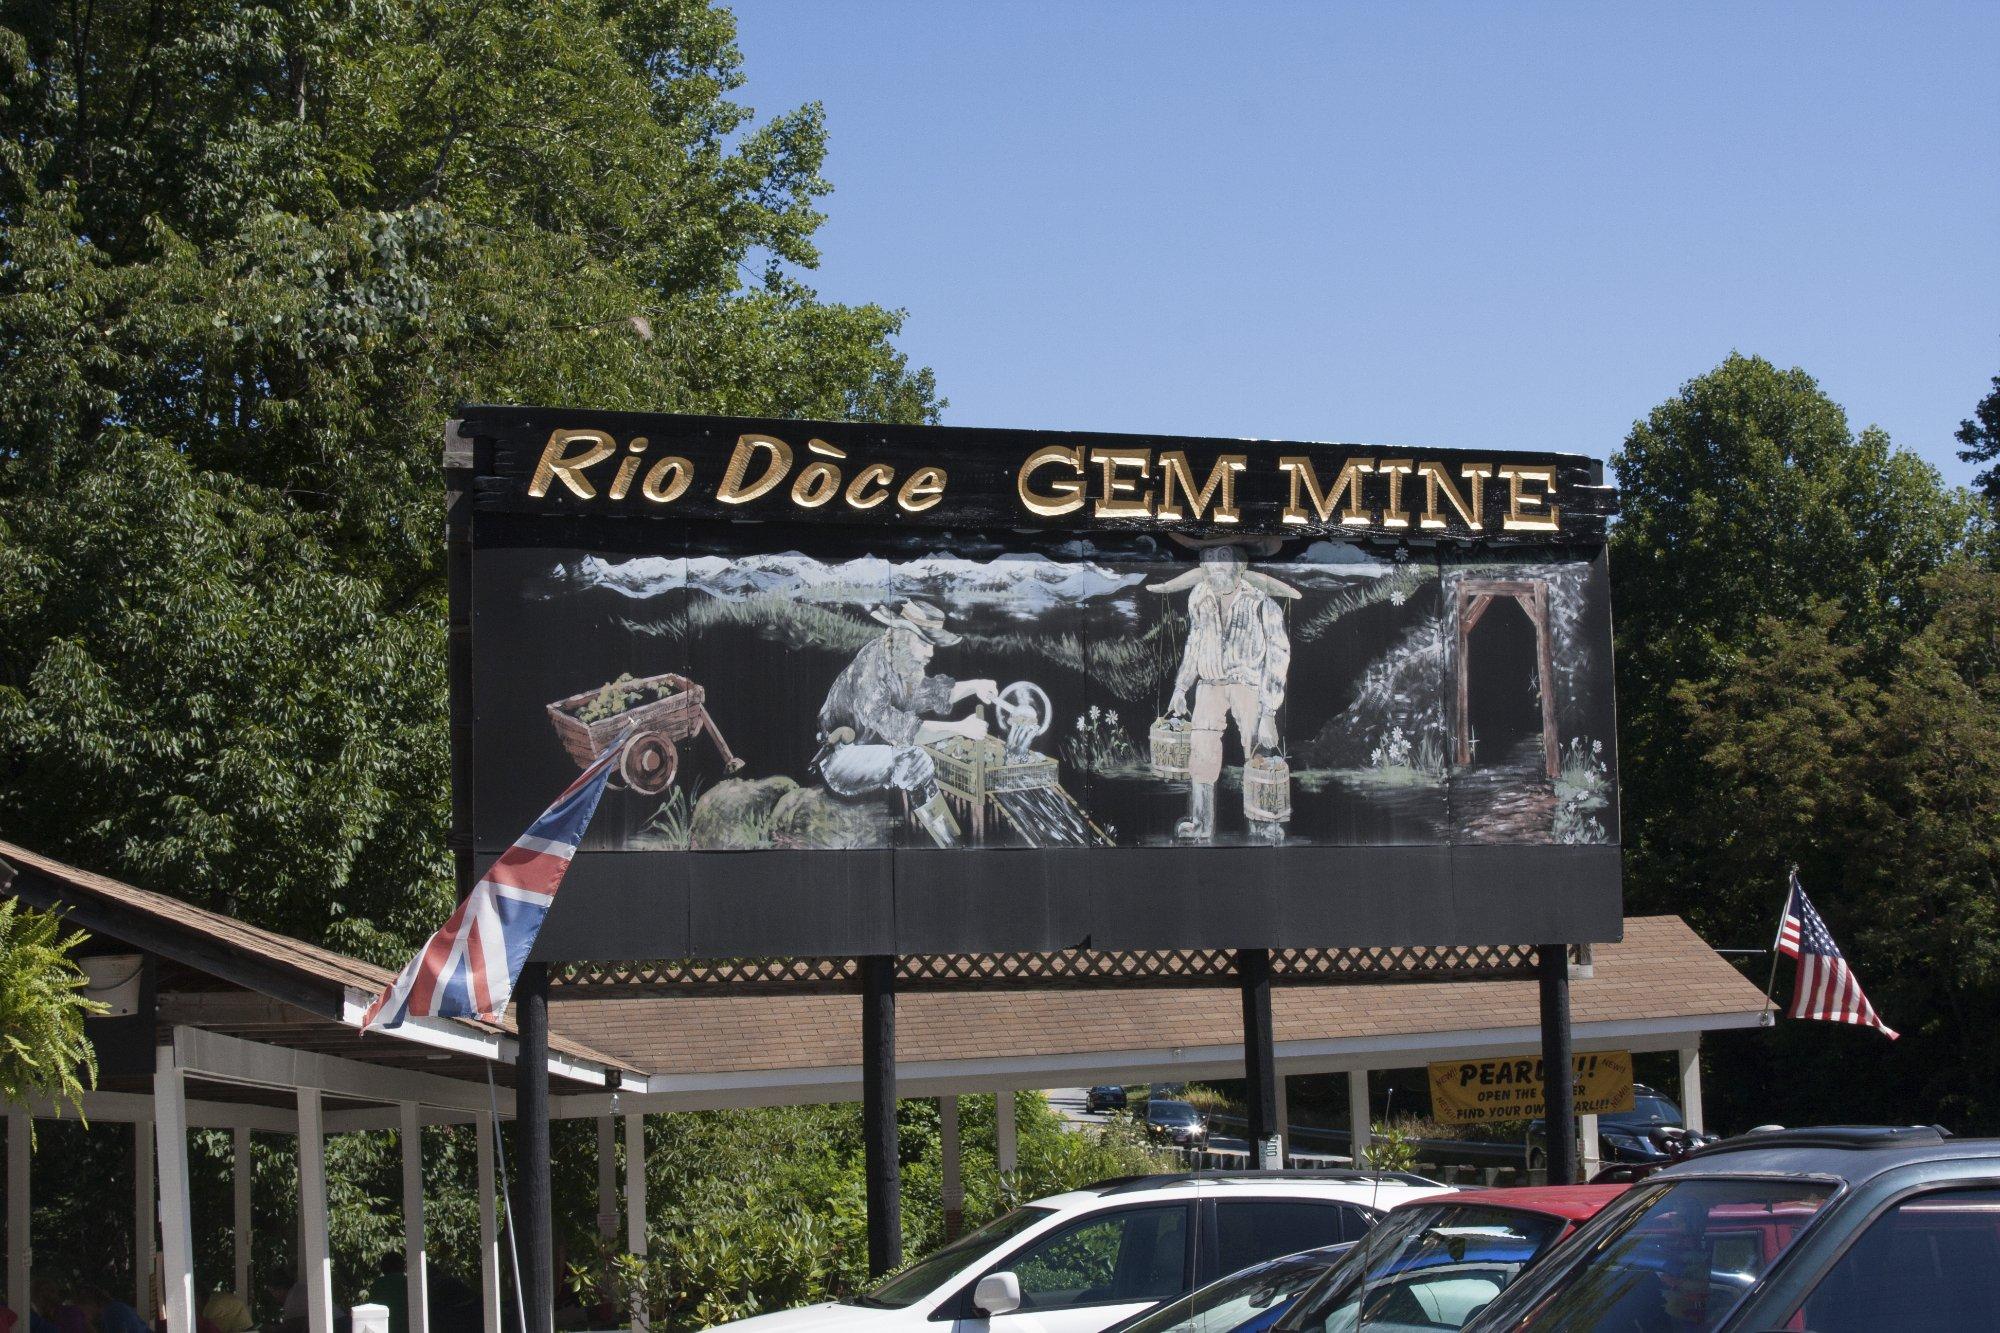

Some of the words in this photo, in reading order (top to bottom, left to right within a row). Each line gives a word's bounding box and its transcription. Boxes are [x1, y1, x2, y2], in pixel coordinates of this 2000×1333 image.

[528, 429, 695, 502] Rio
[1018, 446, 1247, 523] GEM
[1279, 456, 1559, 531] MINE
[1477, 1090, 1510, 1102] OPEN
[1515, 1088, 1536, 1099] THE
[1456, 1108, 1485, 1119] FIND
[1489, 1105, 1521, 1117] YOUR
[1525, 1104, 1545, 1115] OW
